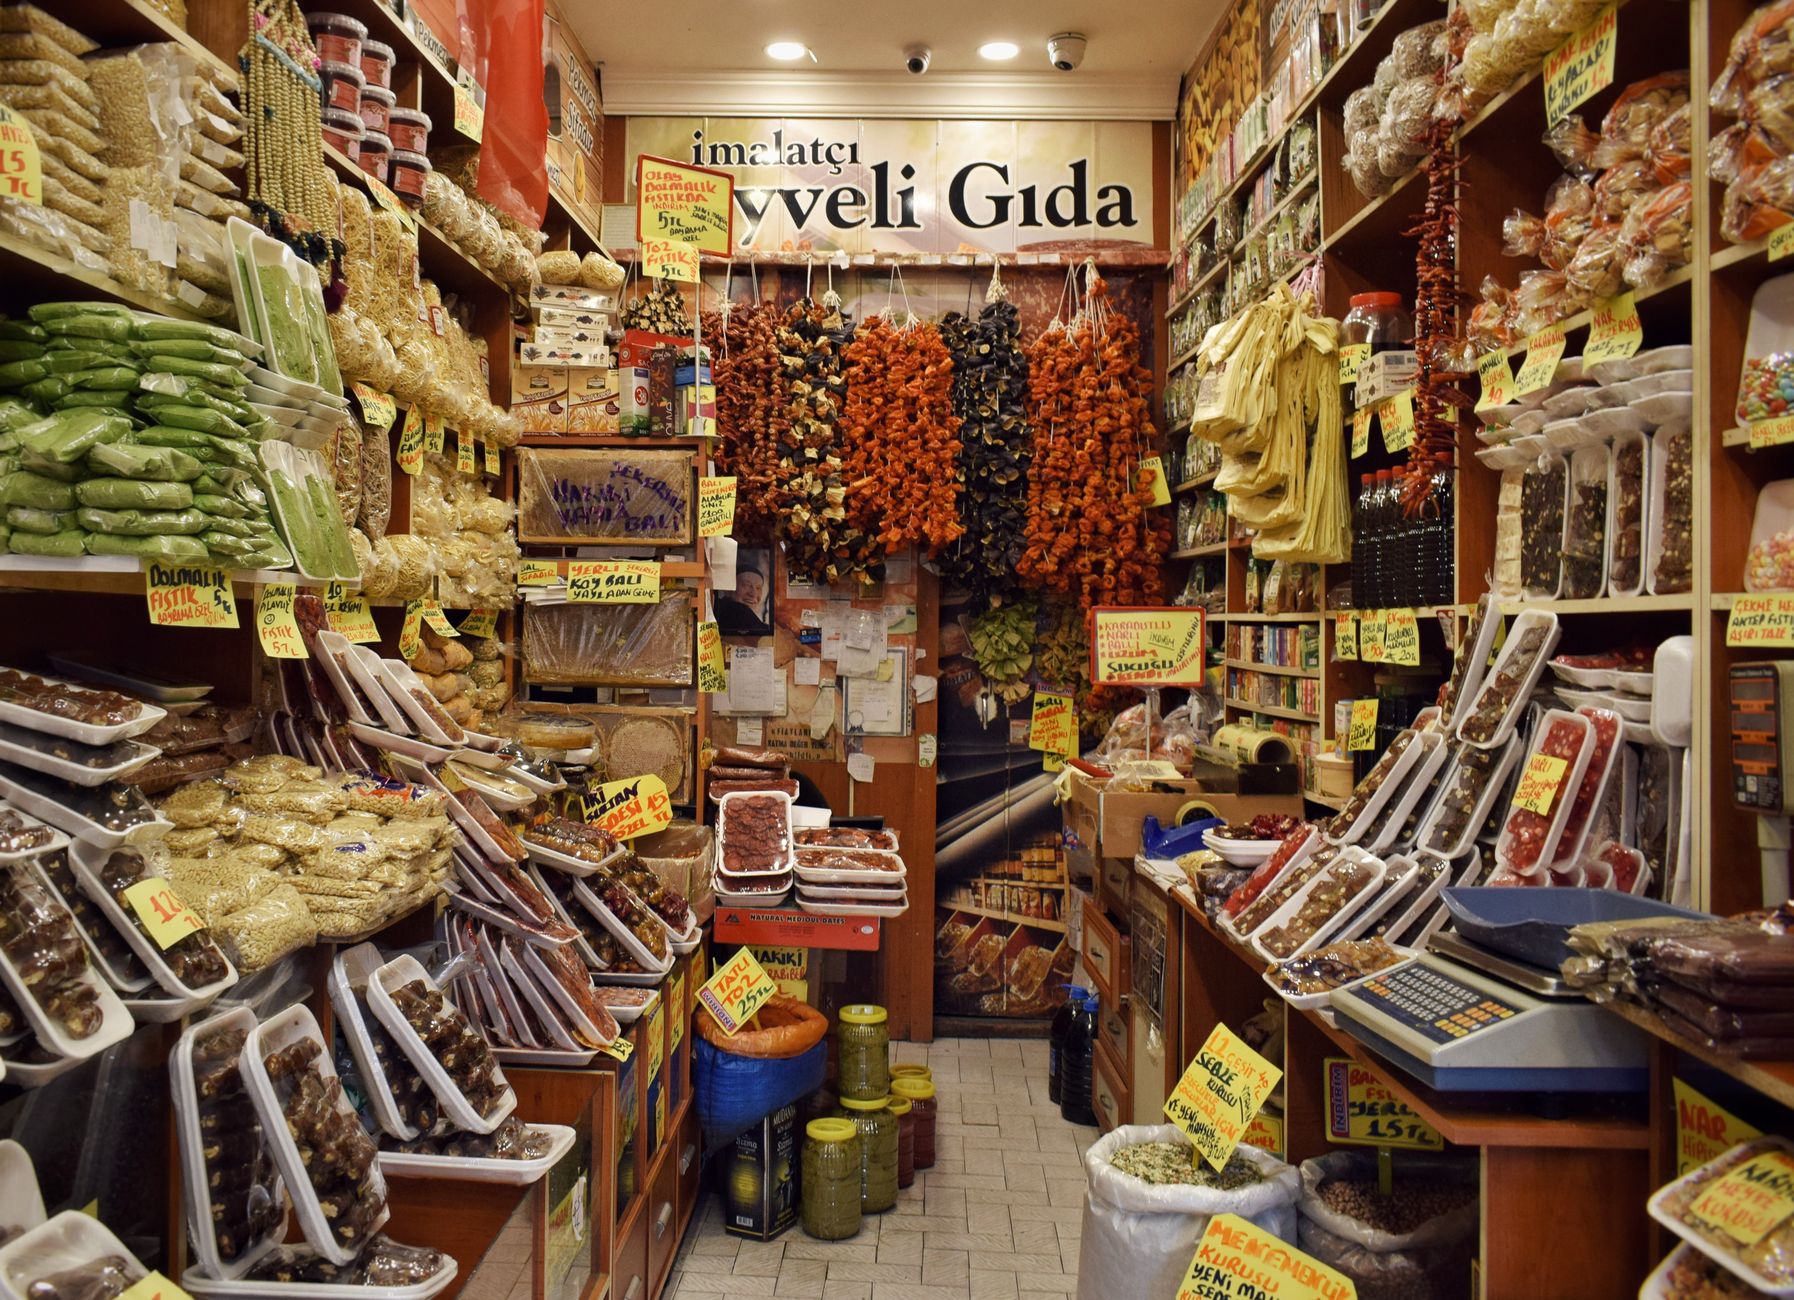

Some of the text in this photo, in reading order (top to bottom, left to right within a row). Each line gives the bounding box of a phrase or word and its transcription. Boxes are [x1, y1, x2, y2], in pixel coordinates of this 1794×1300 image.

[417, 21, 448, 68] Pekmez
[568, 53, 597, 125] Pekmez
[691, 130, 861, 175] imalatçı
[734, 159, 1139, 247] yveli Gıda
[150, 563, 228, 593] DOLMALIK
[605, 573, 642, 588] BALI
[150, 586, 200, 613] FISTIK
[1767, 612, 1794, 626] FISTI
[750, 914, 784, 922] NATURAL
[822, 917, 846, 925] DATES
[714, 956, 751, 994] TATLI
[1348, 1101, 1420, 1118] YERL
[1679, 1098, 1729, 1146] NAR
[1191, 1262, 1232, 1291] YENİ
[1199, 1243, 1280, 1293] KURUSU
